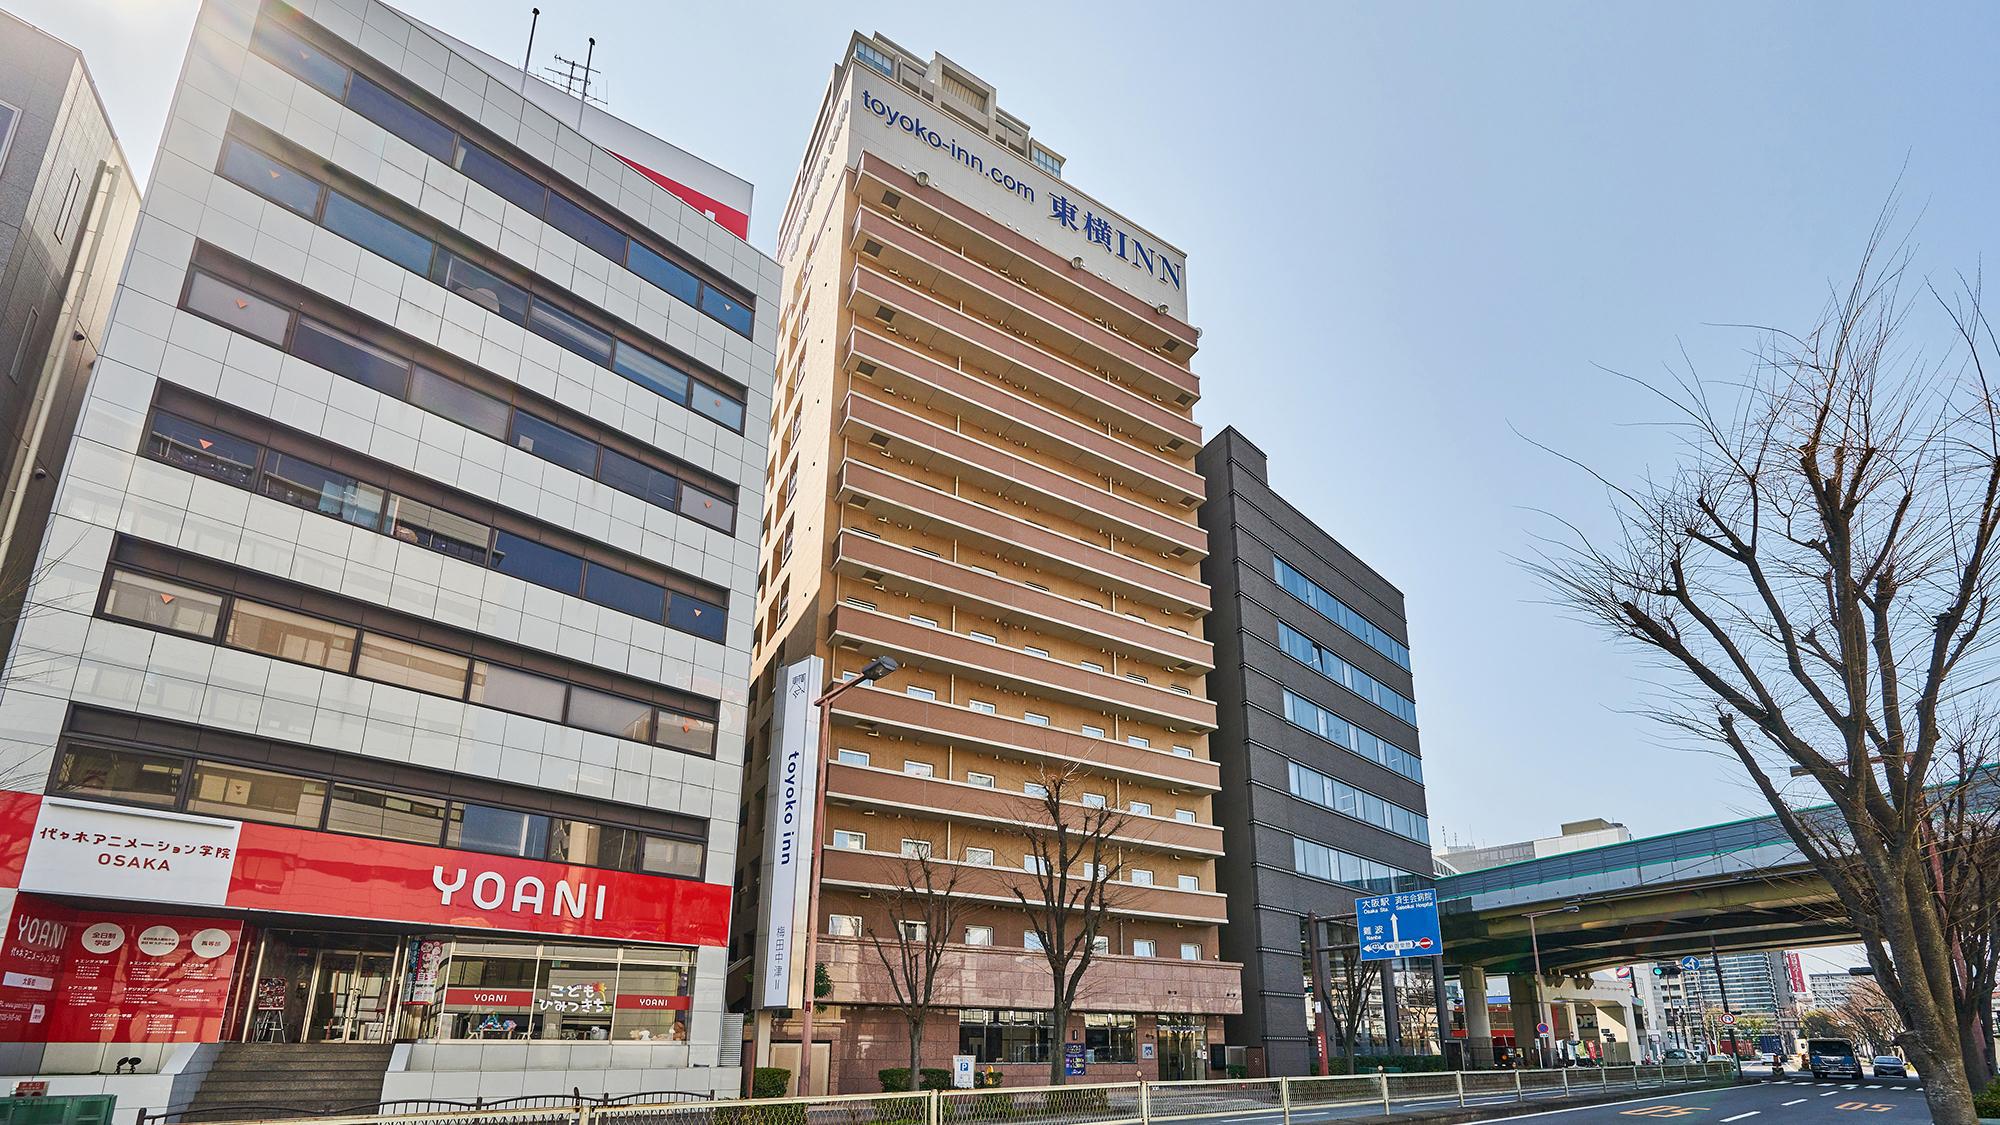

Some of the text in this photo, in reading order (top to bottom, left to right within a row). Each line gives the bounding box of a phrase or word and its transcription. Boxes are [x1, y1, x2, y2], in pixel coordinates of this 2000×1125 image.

[862, 89, 1036, 204] toyoko-inn.com
[1048, 191, 1182, 291] 東横INN
[780, 750, 800, 866] toyoko inn
[39, 826, 232, 861] 代々木アニメーション学院
[97, 852, 171, 872] OSAKA
[431, 864, 608, 921] YOANI
[1362, 897, 1390, 909] 大阪駅
[17, 913, 69, 950] YOANI
[473, 992, 508, 1004] YOANI
[549, 984, 595, 998] こども
[638, 997, 669, 1008] YOANI
[538, 998, 605, 1013] ひみつきち
